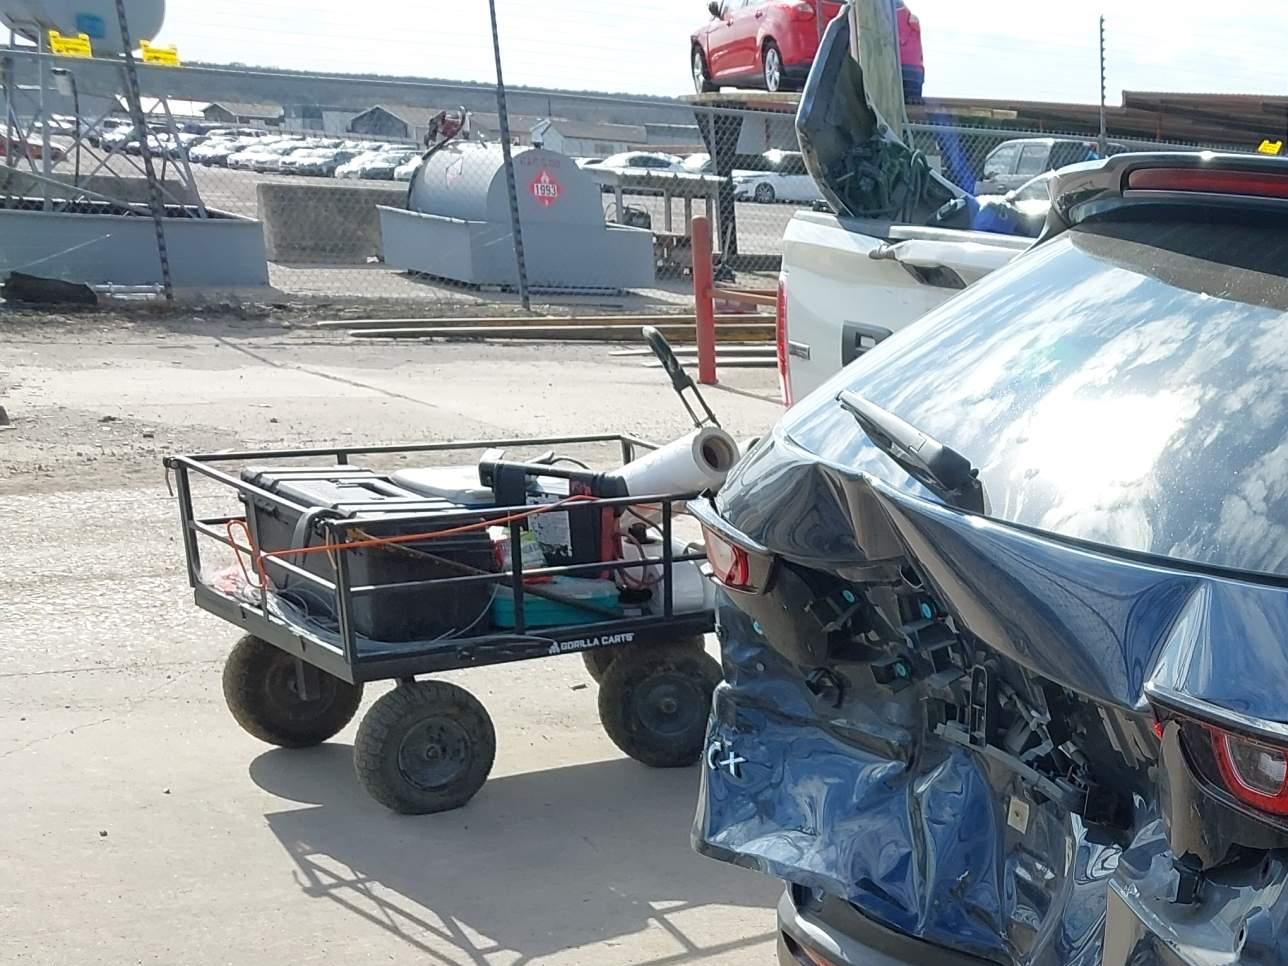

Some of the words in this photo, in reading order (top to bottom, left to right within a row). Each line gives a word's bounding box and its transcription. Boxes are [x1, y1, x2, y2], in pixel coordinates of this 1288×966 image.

[535, 184, 557, 196] 1993
[561, 638, 600, 651] GORILLA
[601, 633, 633, 646] CARTS
